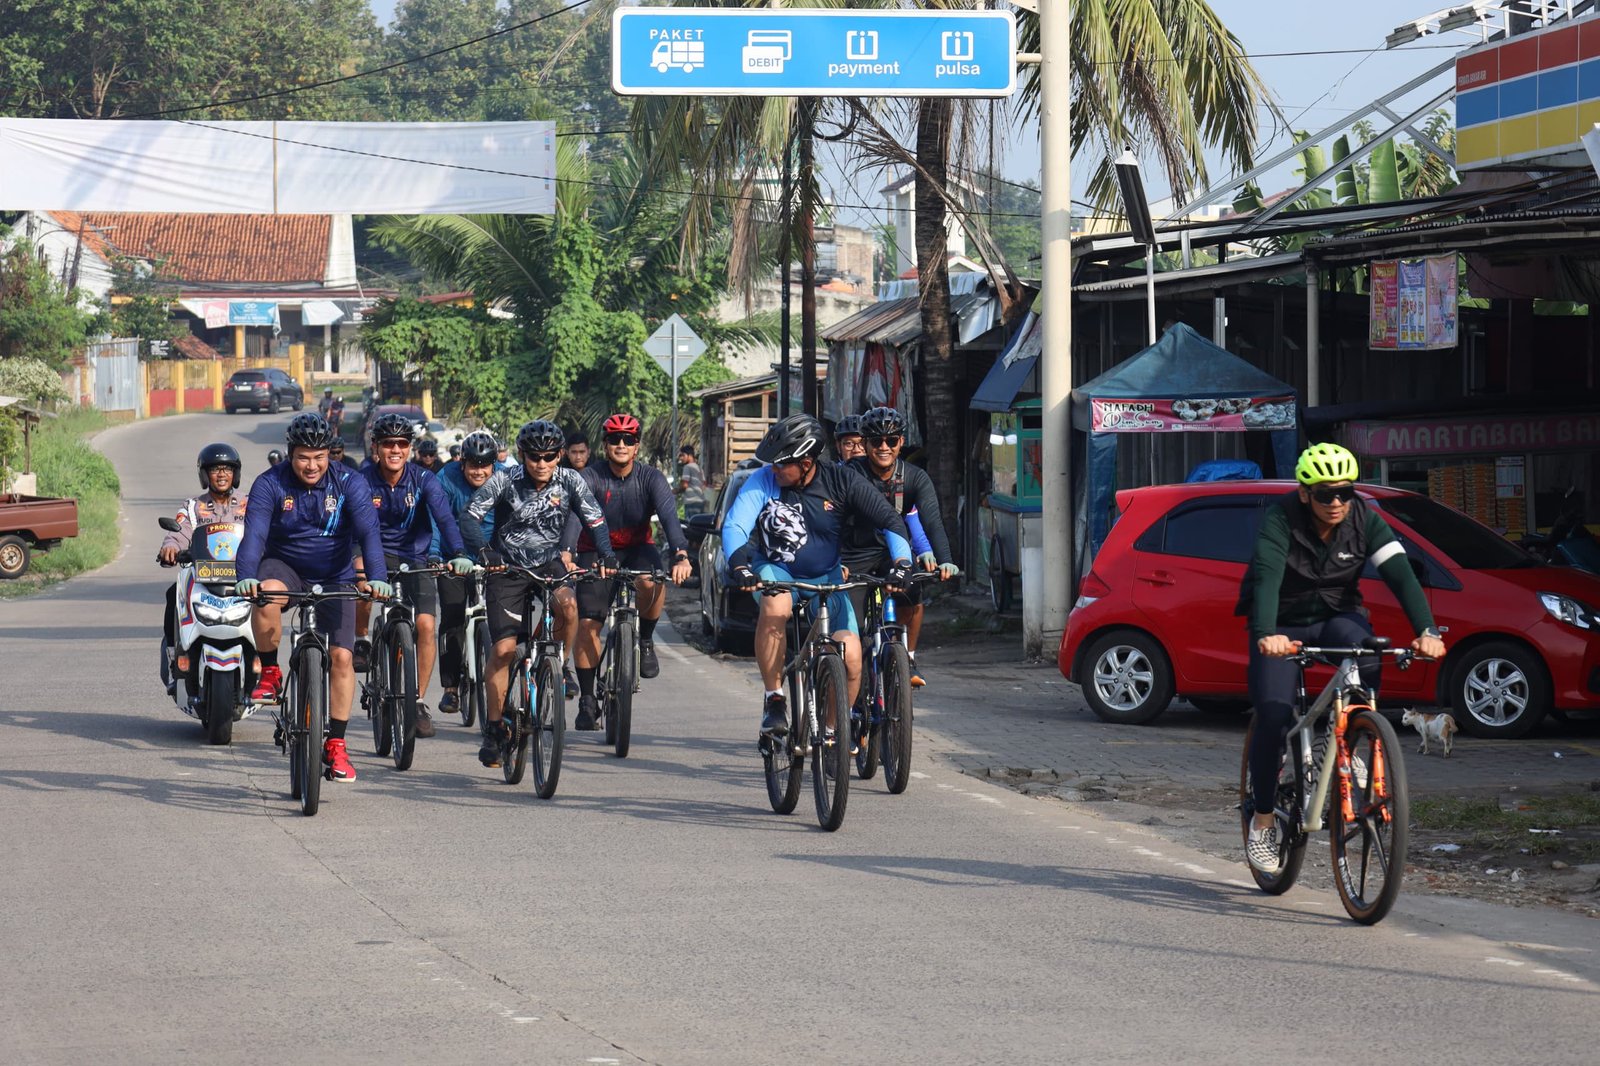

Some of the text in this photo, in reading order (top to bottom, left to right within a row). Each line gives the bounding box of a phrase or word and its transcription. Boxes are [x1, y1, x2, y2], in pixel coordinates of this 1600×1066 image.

[649, 28, 704, 40] PAKET
[748, 57, 781, 68] DEBIT
[828, 60, 900, 78] payment
[935, 61, 981, 77] pulsa
[1387, 422, 1546, 450] MARTABAK
[213, 567, 237, 577] 18009X
